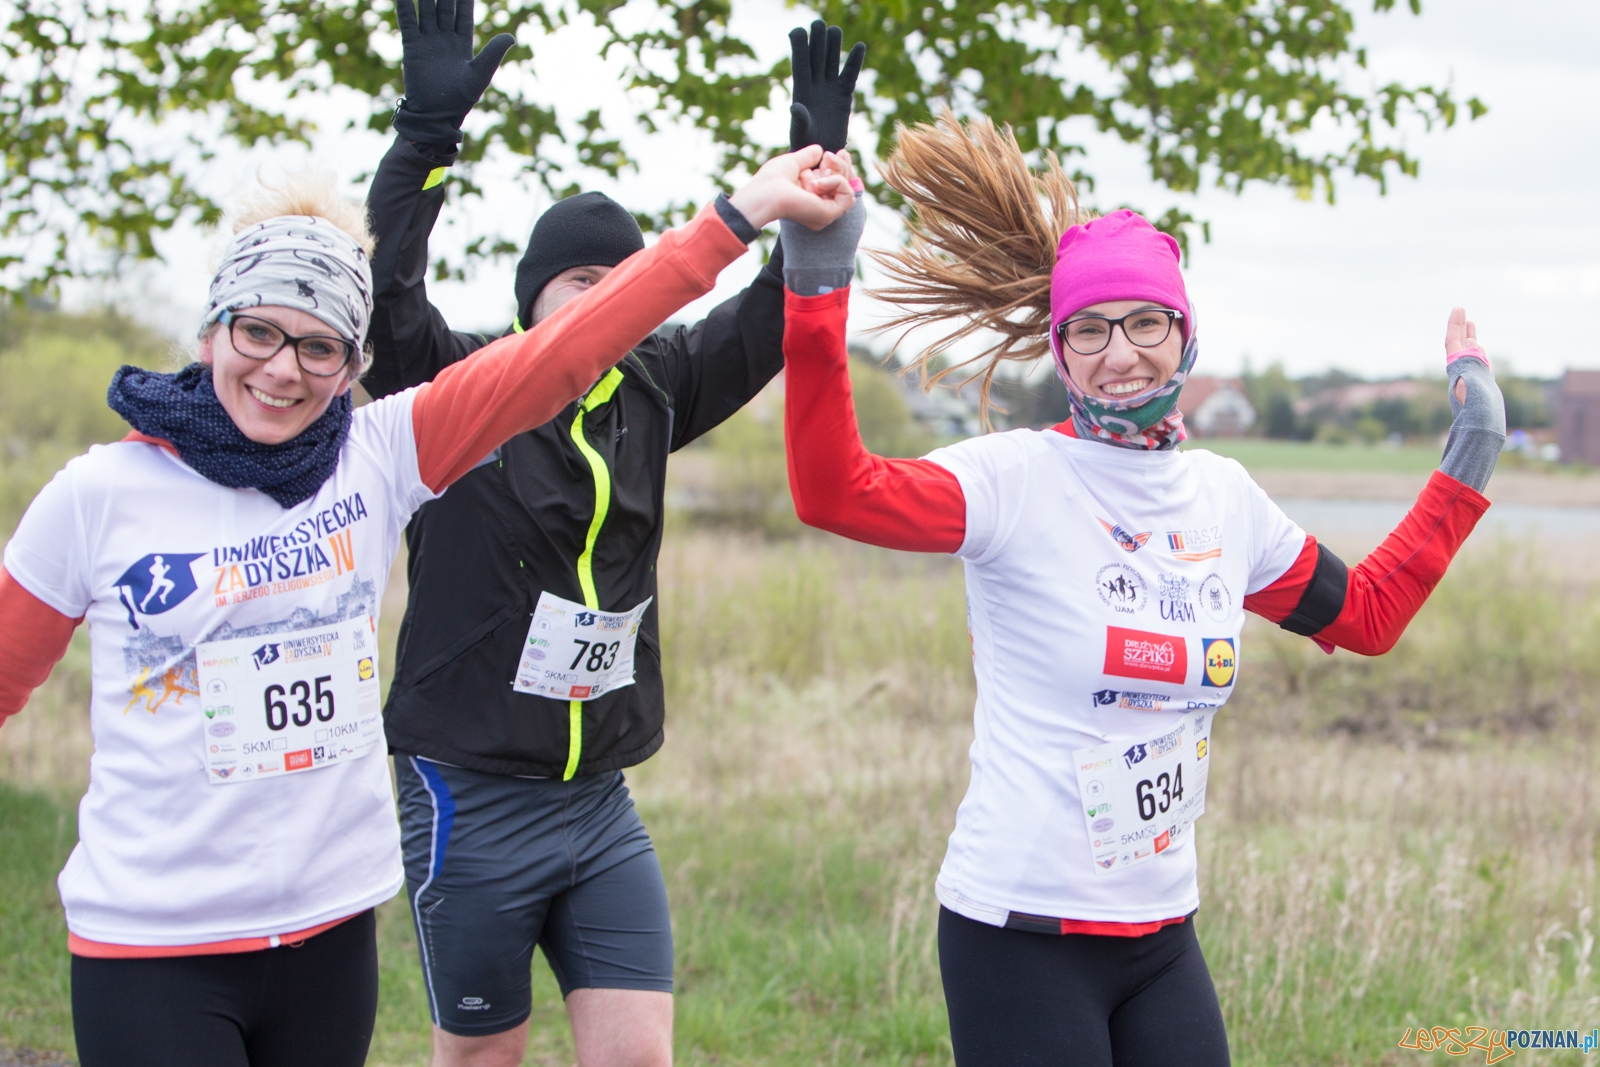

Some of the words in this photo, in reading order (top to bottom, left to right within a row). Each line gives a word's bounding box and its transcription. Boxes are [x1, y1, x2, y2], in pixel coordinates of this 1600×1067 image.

[213, 492, 368, 567] UNIWERSYTECKA
[213, 546, 331, 595] ZADYSZKA
[328, 528, 355, 577] IV
[215, 596, 231, 609] IM.
[232, 586, 271, 605] JERZEGO
[1114, 605, 1135, 615] UAM
[1159, 600, 1196, 622] UAM
[282, 631, 340, 650] UNIWERSYTECKA
[1124, 639, 1166, 652] DRUŻYNA
[284, 644, 323, 661] ZADYSZKA
[322, 642, 332, 657] IV
[569, 638, 621, 673] 783
[1123, 648, 1175, 665] SZPIKU
[544, 670, 566, 681] 5KM
[264, 674, 335, 732] 635
[1119, 698, 1153, 709] ZADYSZKA
[1121, 690, 1171, 703] UNIWERSYTECKA
[328, 722, 358, 739] 10KM
[1149, 723, 1186, 748] UNIWERSYTECKA
[242, 740, 272, 755] 5KM
[1151, 739, 1178, 758] ZADYSZKA
[1135, 762, 1184, 821] 634
[1121, 830, 1145, 846] 5KM
